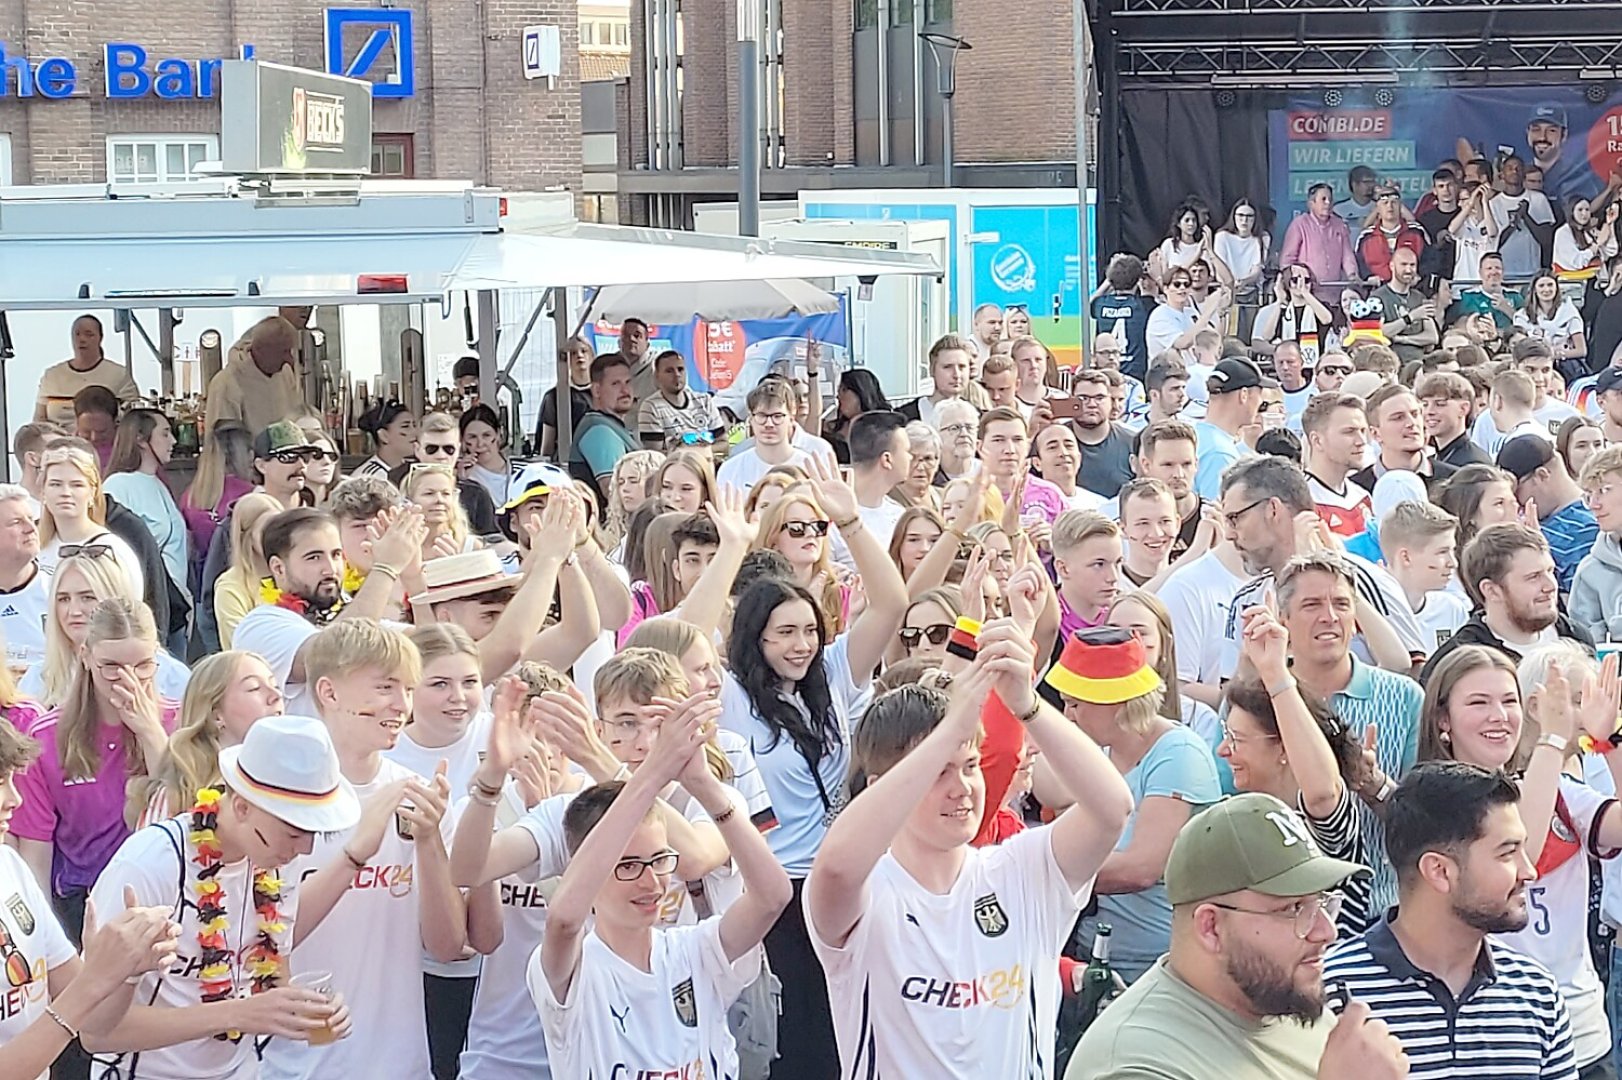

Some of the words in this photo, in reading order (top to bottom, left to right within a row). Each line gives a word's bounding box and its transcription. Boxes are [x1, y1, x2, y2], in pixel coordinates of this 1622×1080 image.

[1292, 116, 1386, 134] COMBI.DE
[1294, 148, 1331, 164] WIR
[1335, 146, 1409, 164] LIEFERN
[1529, 887, 1550, 935] 5
